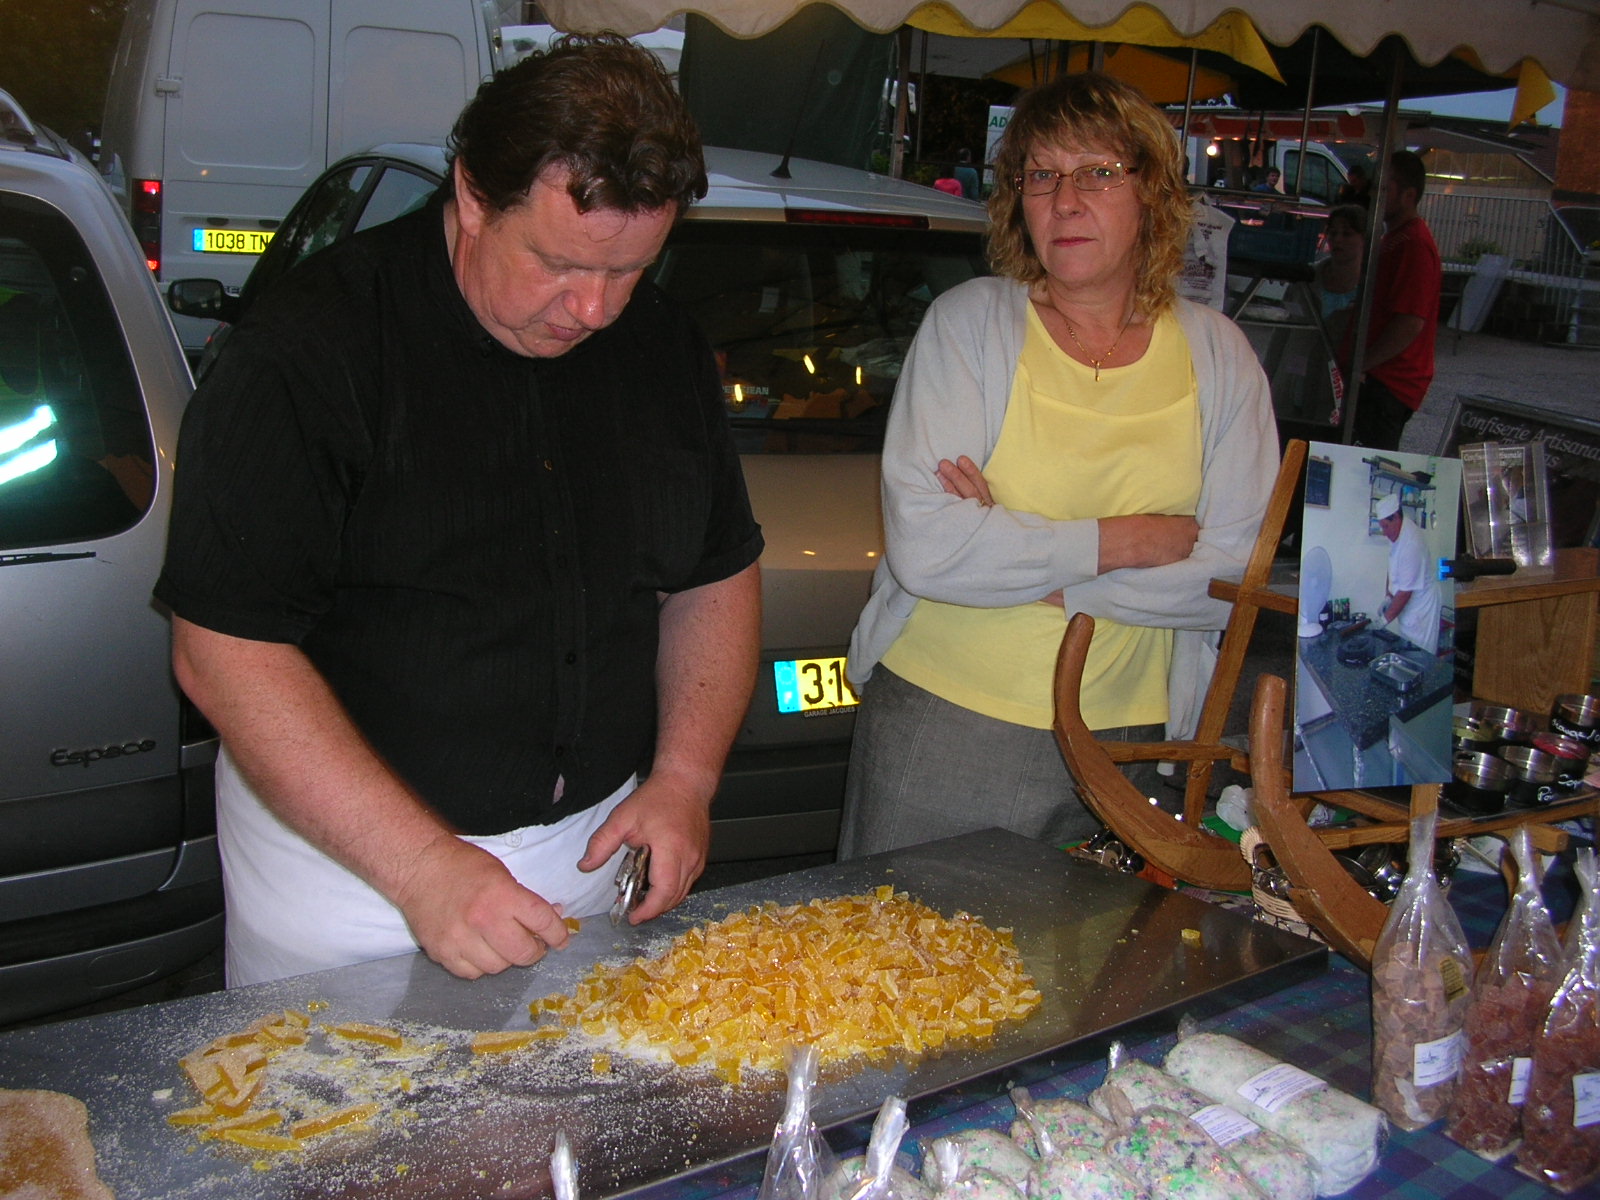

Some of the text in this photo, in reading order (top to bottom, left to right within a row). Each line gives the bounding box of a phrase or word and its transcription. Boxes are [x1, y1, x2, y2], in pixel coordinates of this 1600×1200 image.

[207, 232, 246, 250] 1038
[1460, 411, 1531, 440] Confiserie
[804, 706, 856, 719] GARAGE JACQUES
[50, 740, 157, 768] Espace
